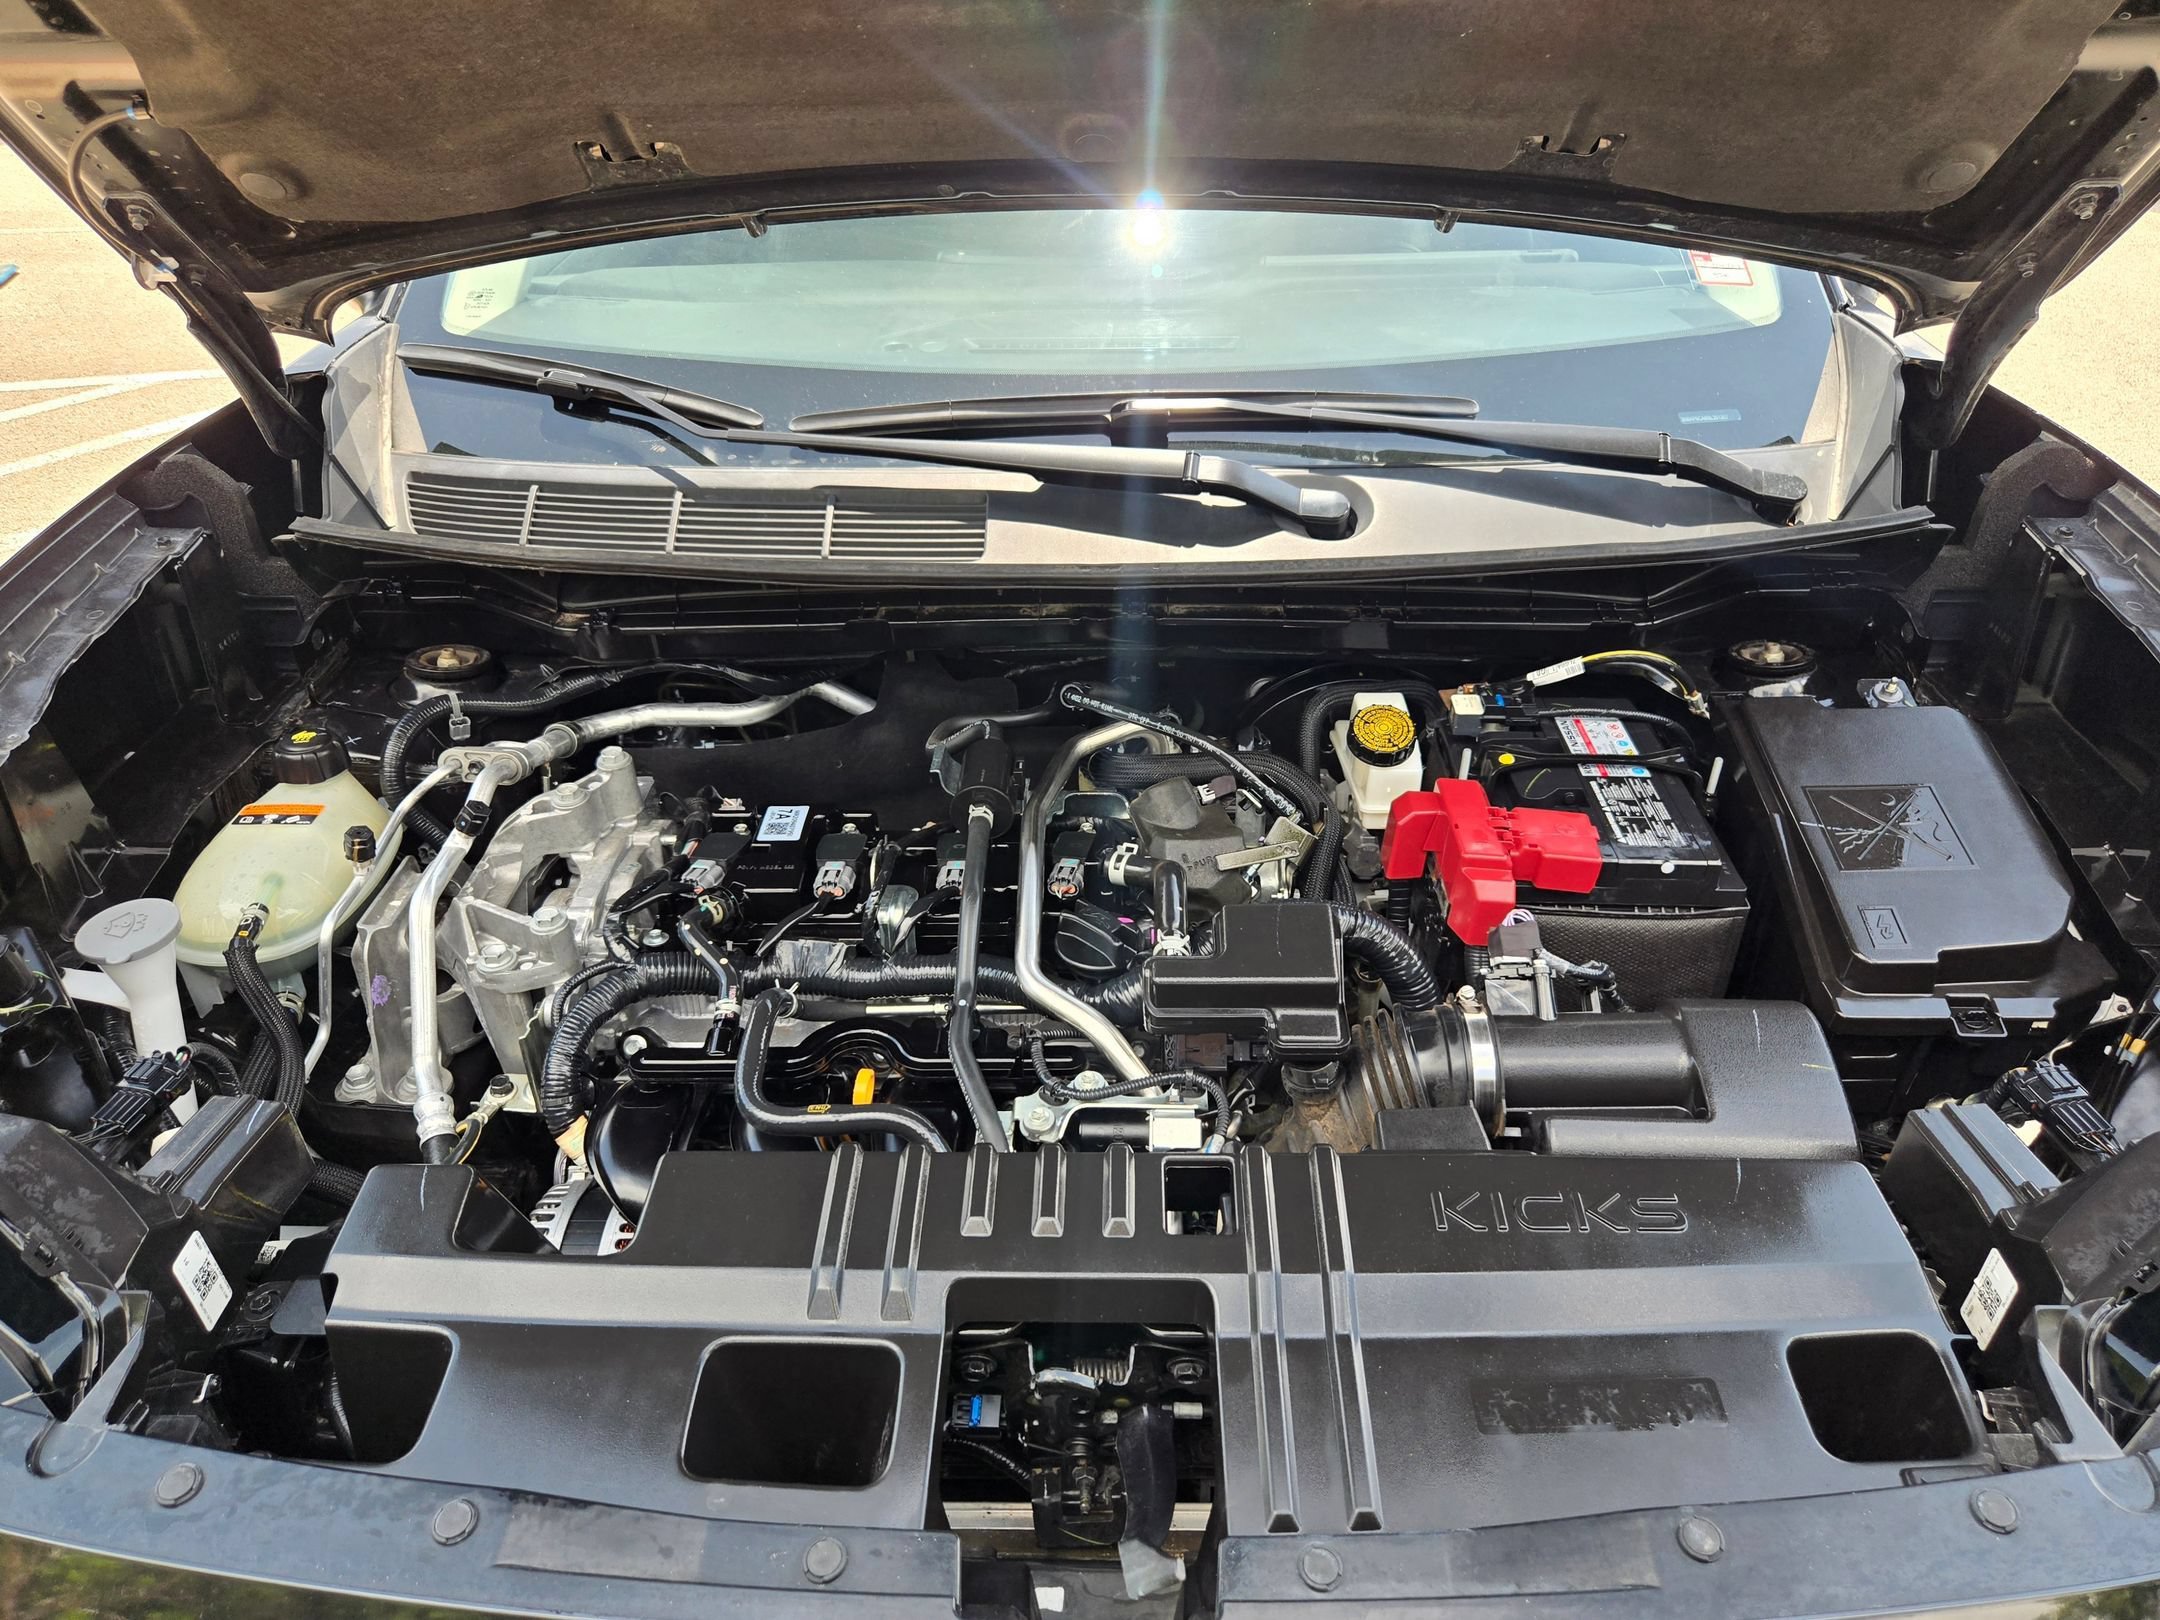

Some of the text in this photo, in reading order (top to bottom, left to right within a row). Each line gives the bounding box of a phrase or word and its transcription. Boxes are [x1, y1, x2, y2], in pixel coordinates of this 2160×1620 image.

[1561, 720, 1579, 747] NISSAN
[775, 809, 793, 820] 7A
[1430, 1191, 1688, 1232] KICKS
